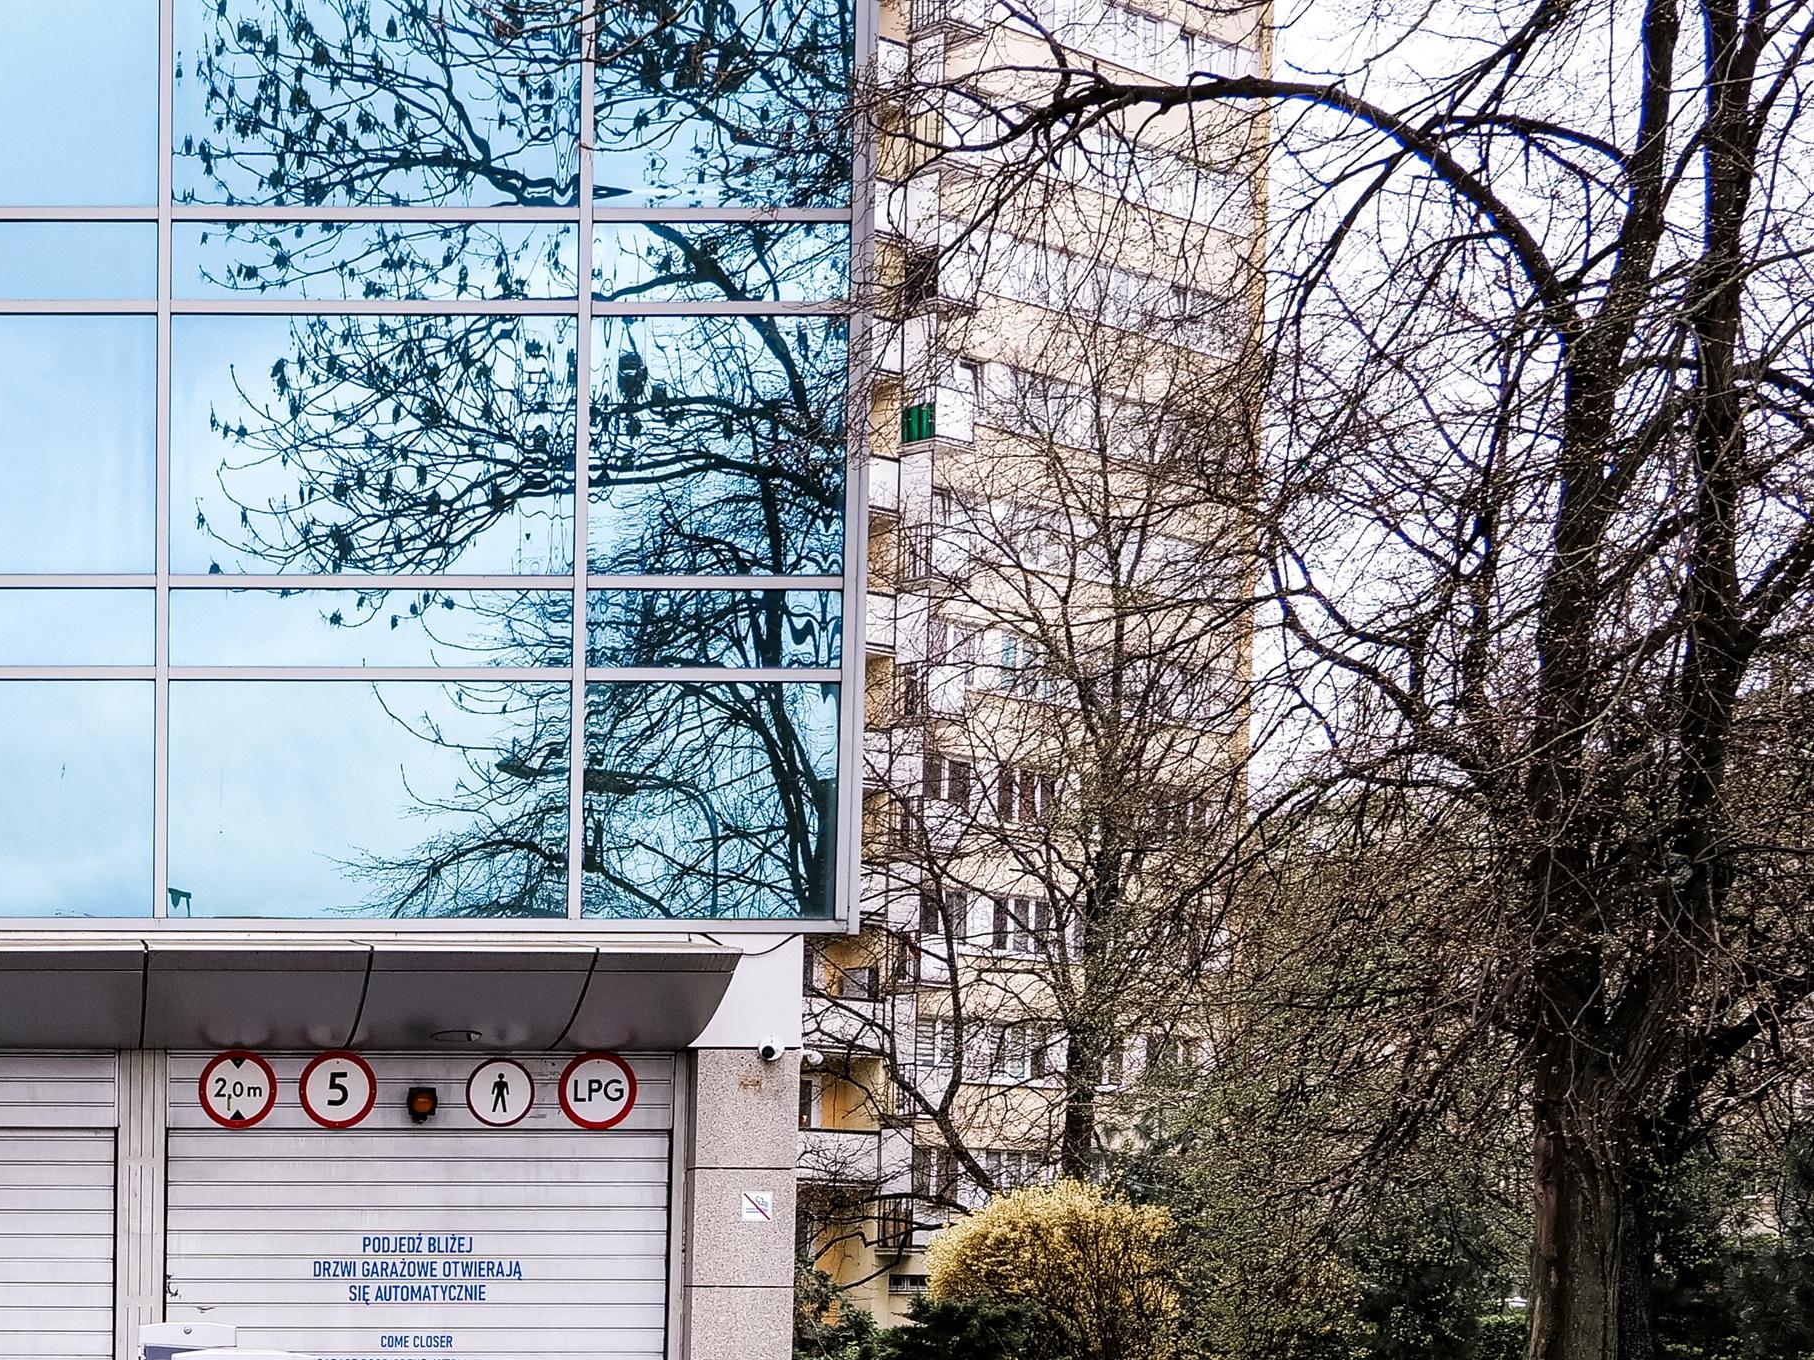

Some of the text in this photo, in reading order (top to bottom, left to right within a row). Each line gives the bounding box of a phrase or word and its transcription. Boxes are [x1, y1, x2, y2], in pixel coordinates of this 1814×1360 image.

[327, 1072, 349, 1107] 5
[573, 1079, 624, 1102] LPG
[362, 1233, 473, 1253] PODJEDŹ BLIŻEJ
[313, 1258, 522, 1280] DRZWI GARAŻOWE OTWIERAJĄ
[349, 1285, 486, 1305] SIĘ AUTOMATYCZNIE
[380, 1335, 453, 1348] COME CLOSER
